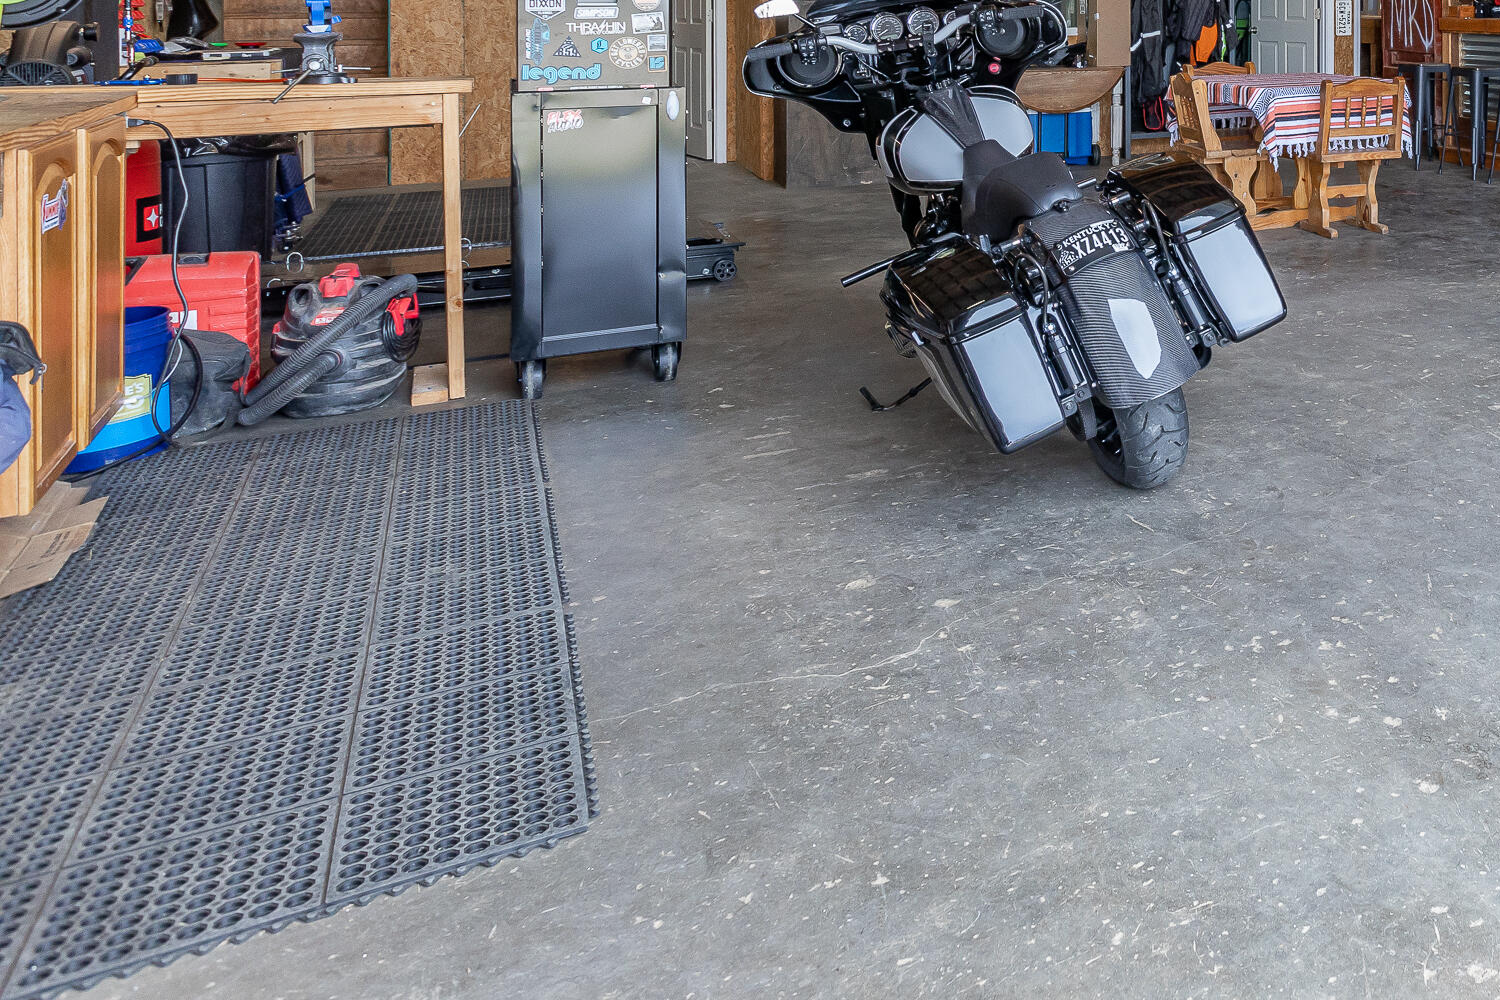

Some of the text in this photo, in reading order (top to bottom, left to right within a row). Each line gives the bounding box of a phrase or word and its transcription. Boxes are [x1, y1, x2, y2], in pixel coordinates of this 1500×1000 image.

[529, 0, 561, 8] DIXXON
[577, 9, 616, 17] SIMPSON
[616, 56, 642, 68] CYCLES
[522, 63, 602, 85] legend
[1063, 222, 1111, 247] KENTUCKY
[1071, 227, 1129, 259] XZ4413
